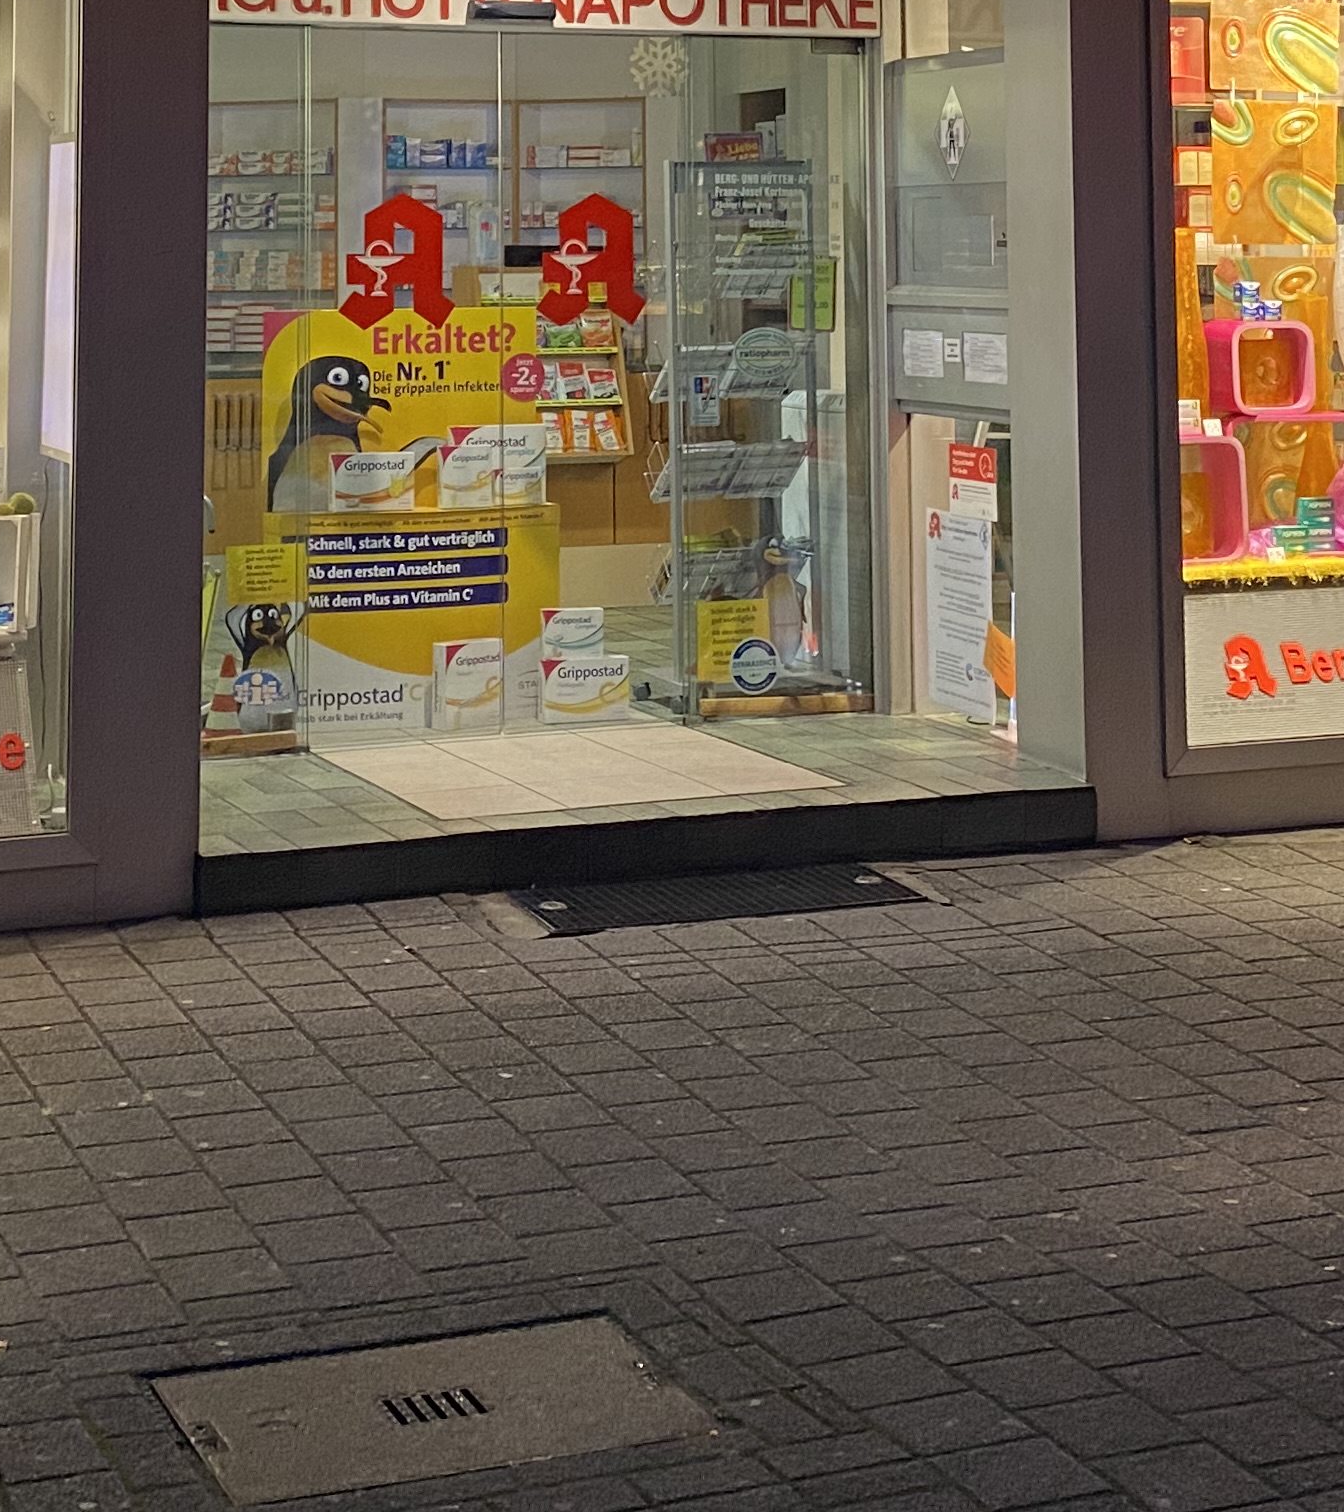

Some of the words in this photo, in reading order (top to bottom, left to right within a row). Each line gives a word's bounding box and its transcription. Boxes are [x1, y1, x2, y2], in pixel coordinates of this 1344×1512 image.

[373, 322, 517, 355] Erkältet?
[739, 349, 790, 359] ratiopharm
[373, 370, 393, 382] Die
[396, 361, 427, 381] Nr.
[373, 383, 391, 394] bei
[394, 382, 451, 397] grippalen
[344, 458, 405, 473] Grippostad
[307, 535, 357, 552] Schnell,
[359, 534, 392, 550] stark
[394, 534, 406, 549] &
[407, 535, 430, 551] gut
[431, 530, 495, 548] verträglich
[307, 566, 325, 581] Ab
[327, 565, 353, 580] den
[354, 563, 395, 578] ersten
[397, 560, 461, 576] Anzeichen
[307, 594, 330, 609] Mit
[331, 592, 362, 607] dem
[363, 591, 390, 606] Plus
[392, 593, 409, 605] an
[411, 588, 461, 604] Vitamin
[456, 652, 502, 667] Grippostad
[558, 664, 624, 681] Grippostad
[297, 684, 403, 712] Grippostad
[360, 711, 404, 721] Erkältung
